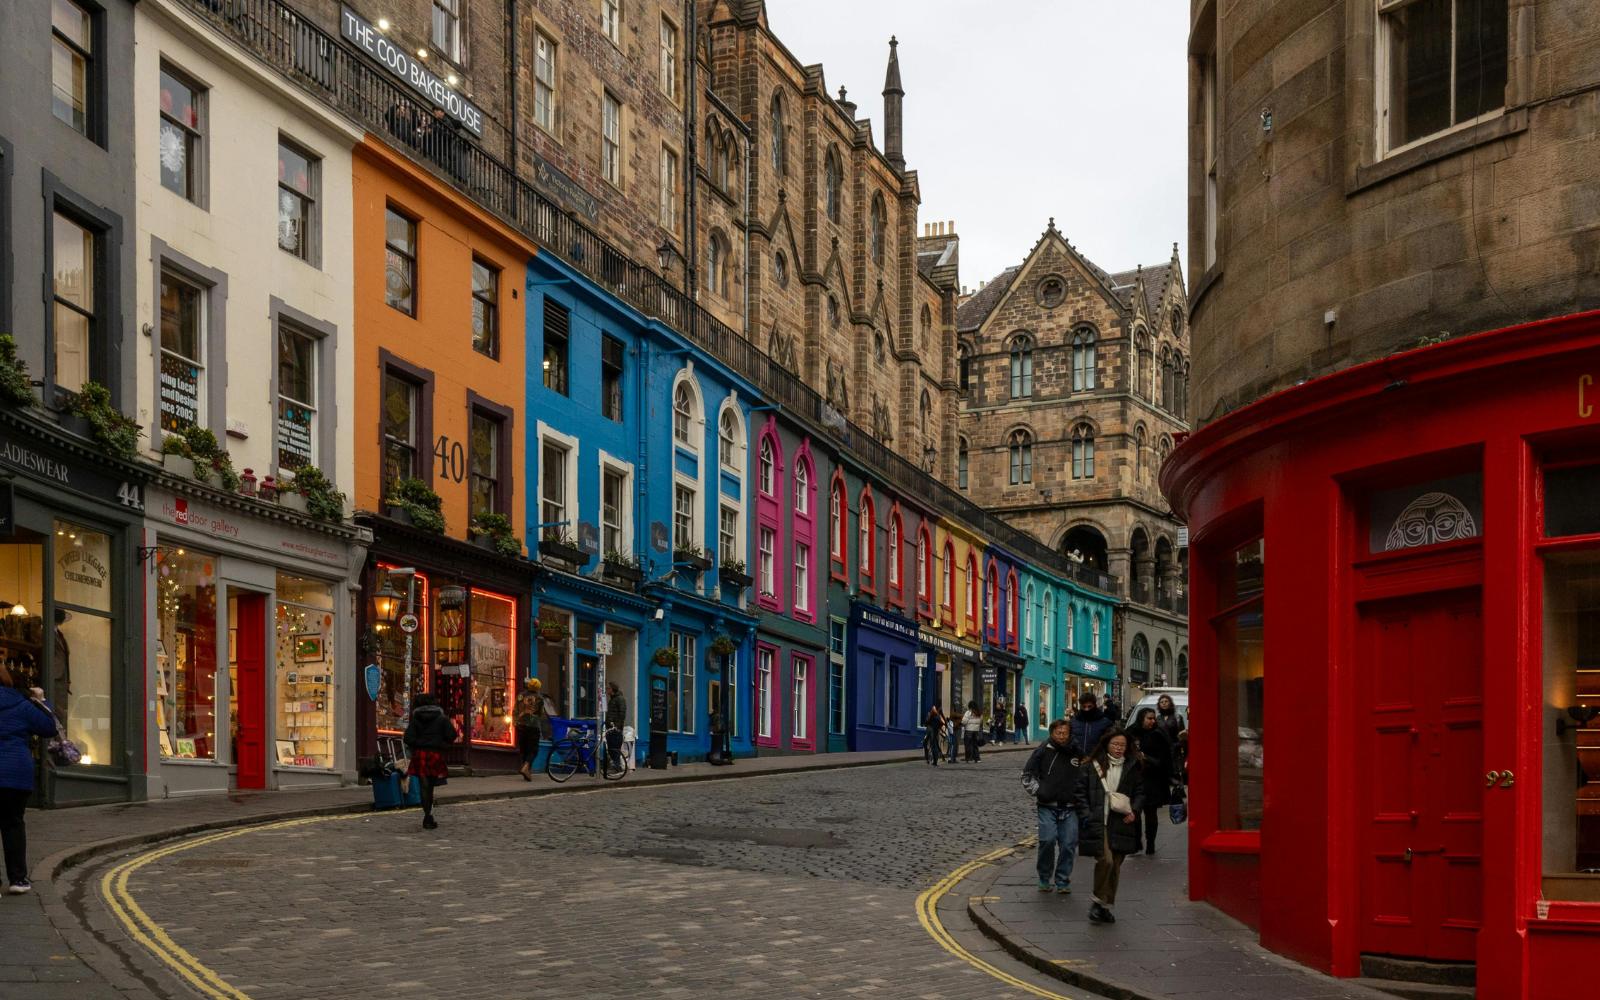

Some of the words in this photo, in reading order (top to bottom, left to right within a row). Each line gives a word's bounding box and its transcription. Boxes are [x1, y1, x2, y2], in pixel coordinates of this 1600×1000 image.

[345, 12, 374, 52] THE
[377, 38, 407, 76] COO
[410, 62, 481, 133] BAKEHOUSE
[161, 387, 175, 401] and
[177, 377, 196, 396] Local
[175, 405, 194, 422] 2003
[433, 435, 464, 483] 40
[163, 503, 175, 518] the
[175, 508, 188, 521] red
[189, 512, 208, 526] door
[211, 519, 239, 537] gallery
[81, 550, 107, 581] LUGGAGE
